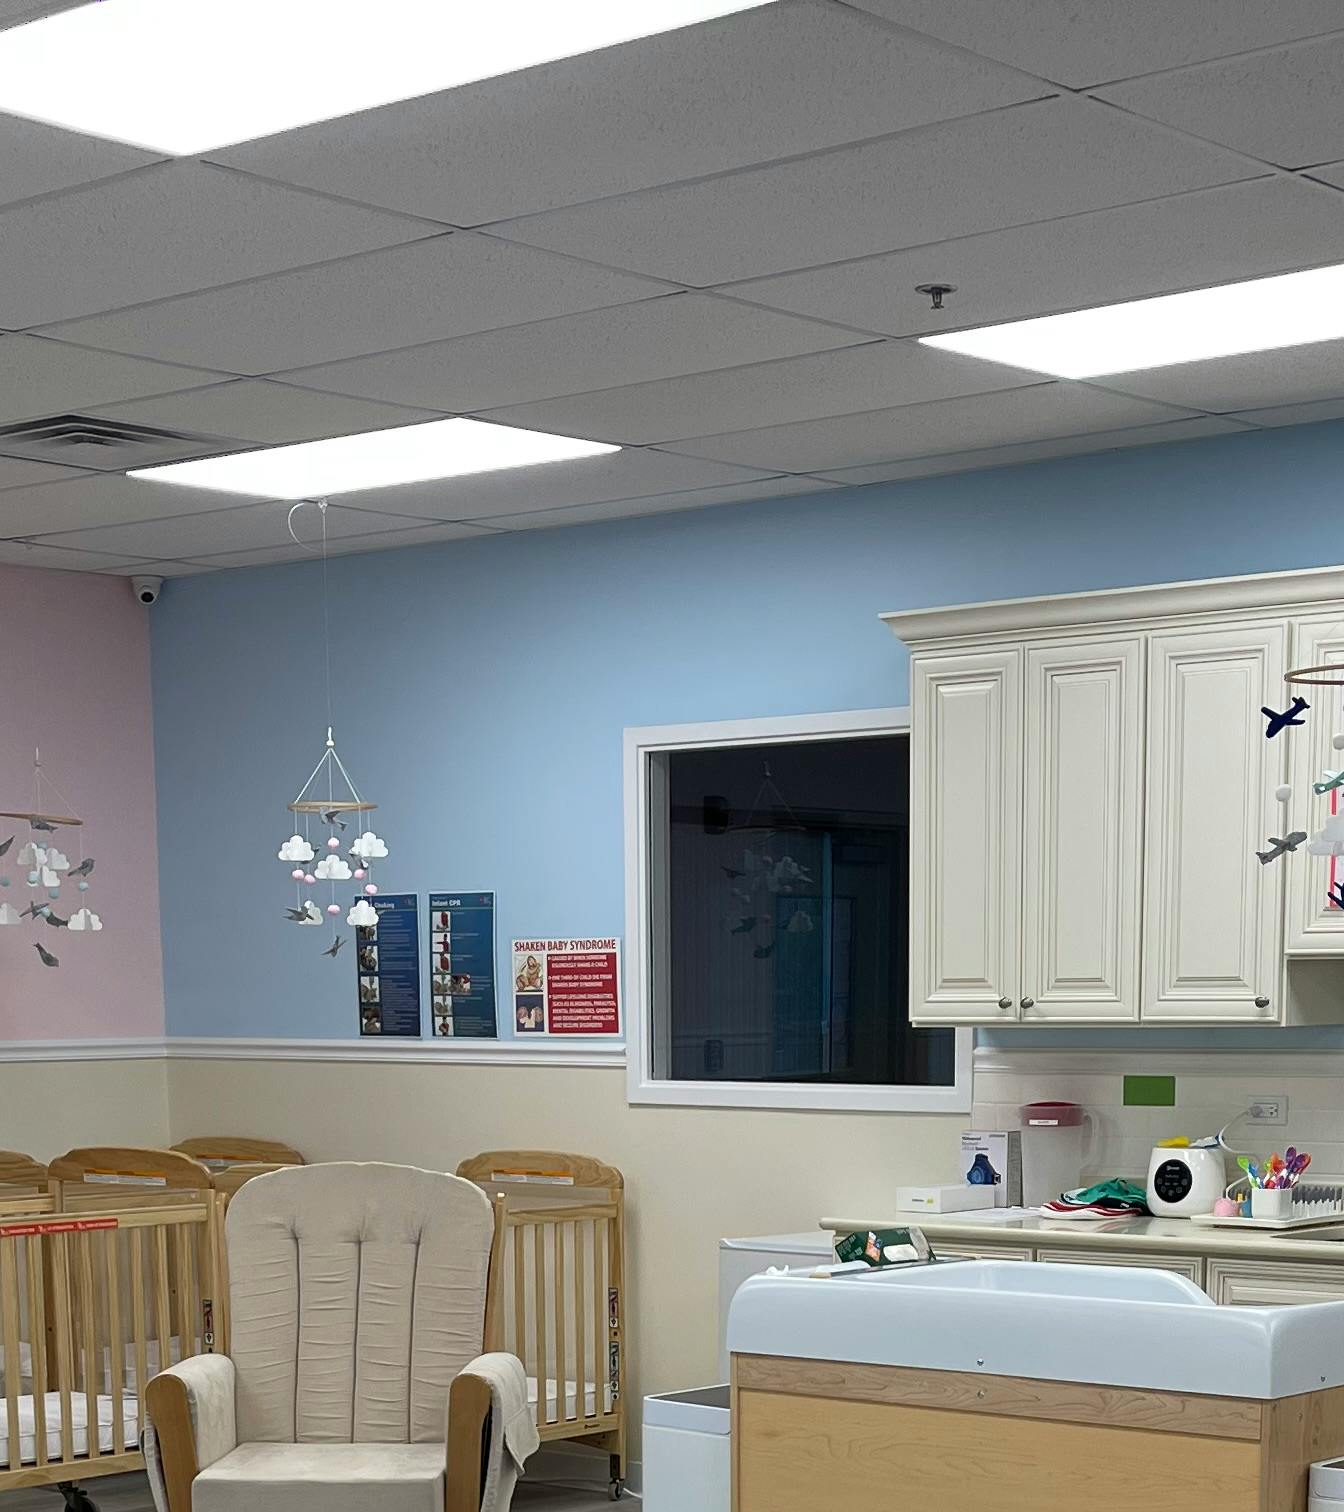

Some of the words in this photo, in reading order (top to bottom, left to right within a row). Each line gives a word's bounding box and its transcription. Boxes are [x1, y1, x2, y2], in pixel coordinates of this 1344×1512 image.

[449, 898, 461, 907] CPR
[514, 941, 546, 952] SHAKEN
[547, 940, 568, 951] BABY
[569, 938, 617, 951] SYNDROME
